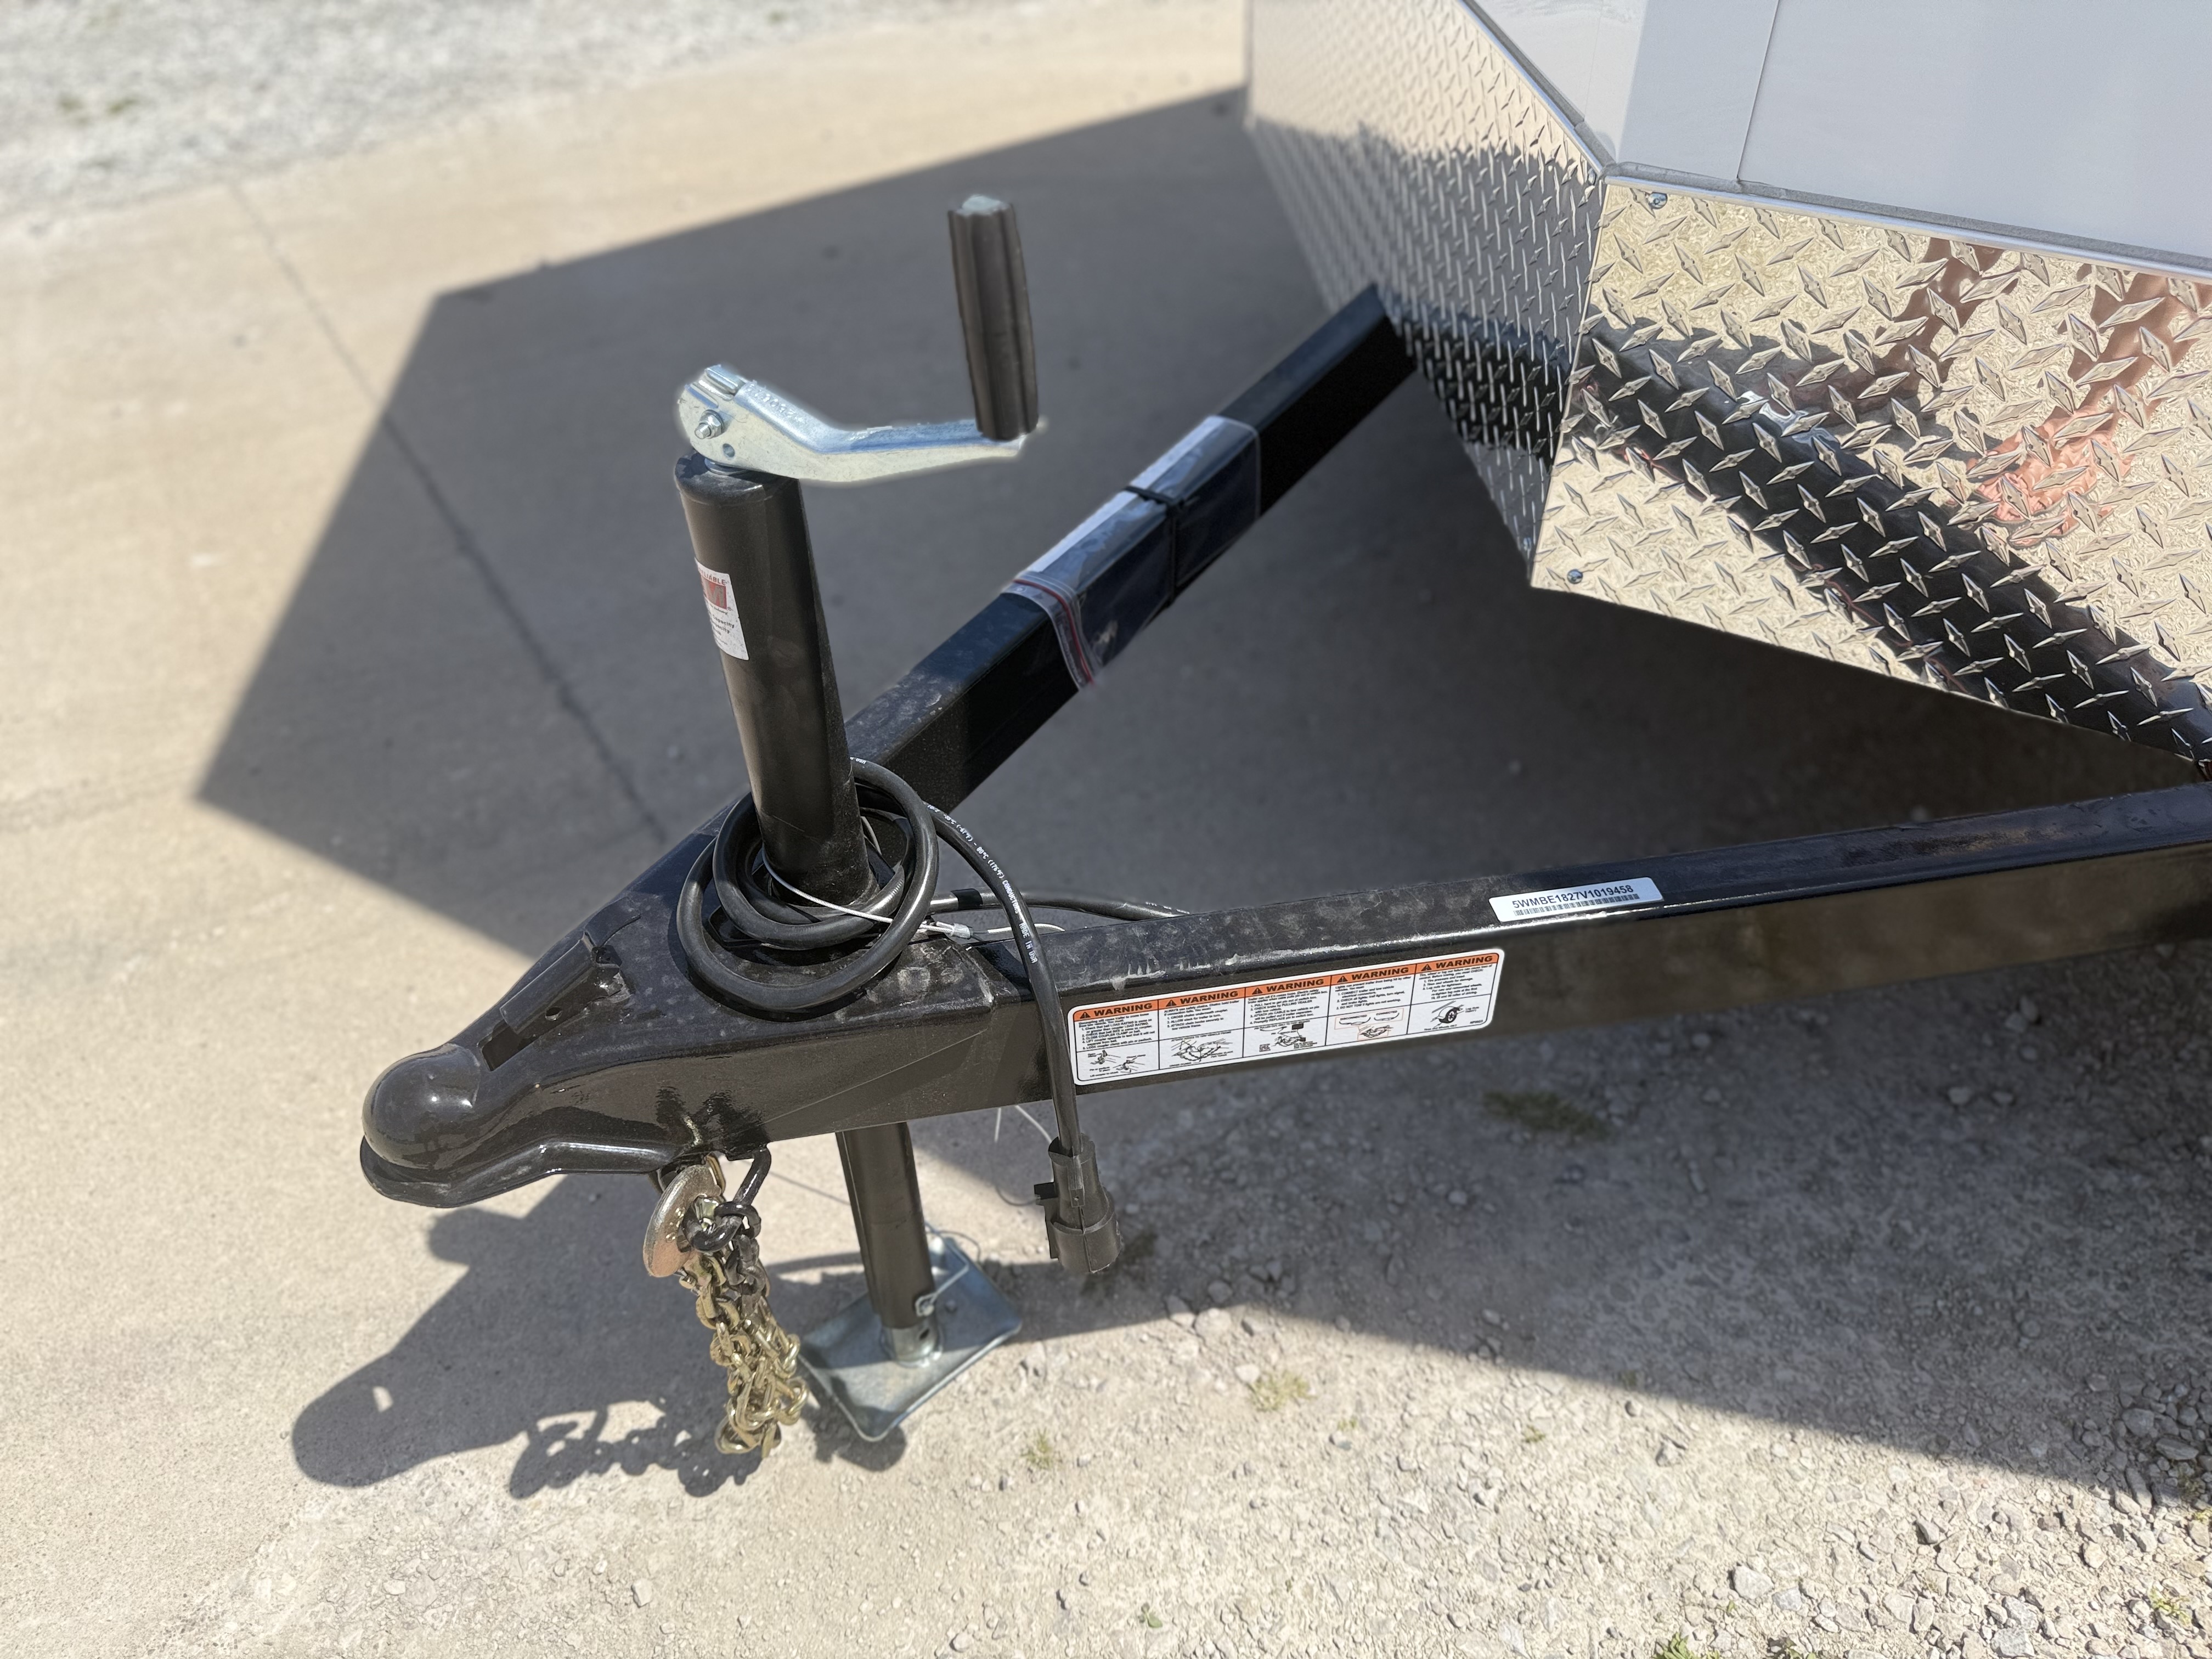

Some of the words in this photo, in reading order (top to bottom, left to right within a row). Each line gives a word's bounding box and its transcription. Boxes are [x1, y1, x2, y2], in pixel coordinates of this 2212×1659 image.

[1512, 885, 1634, 909] 5WMBE1827V1019458
[1019, 922, 1030, 938] MADE
[1025, 940, 1032, 949] IN
[1029, 950, 1037, 963] USA
[1436, 956, 1492, 968] WARNING
[1352, 967, 1408, 980] WARNING
[1266, 979, 1324, 992] WARNING
[1180, 991, 1238, 1004] WARNING
[1094, 1003, 1152, 1016] WARNING
